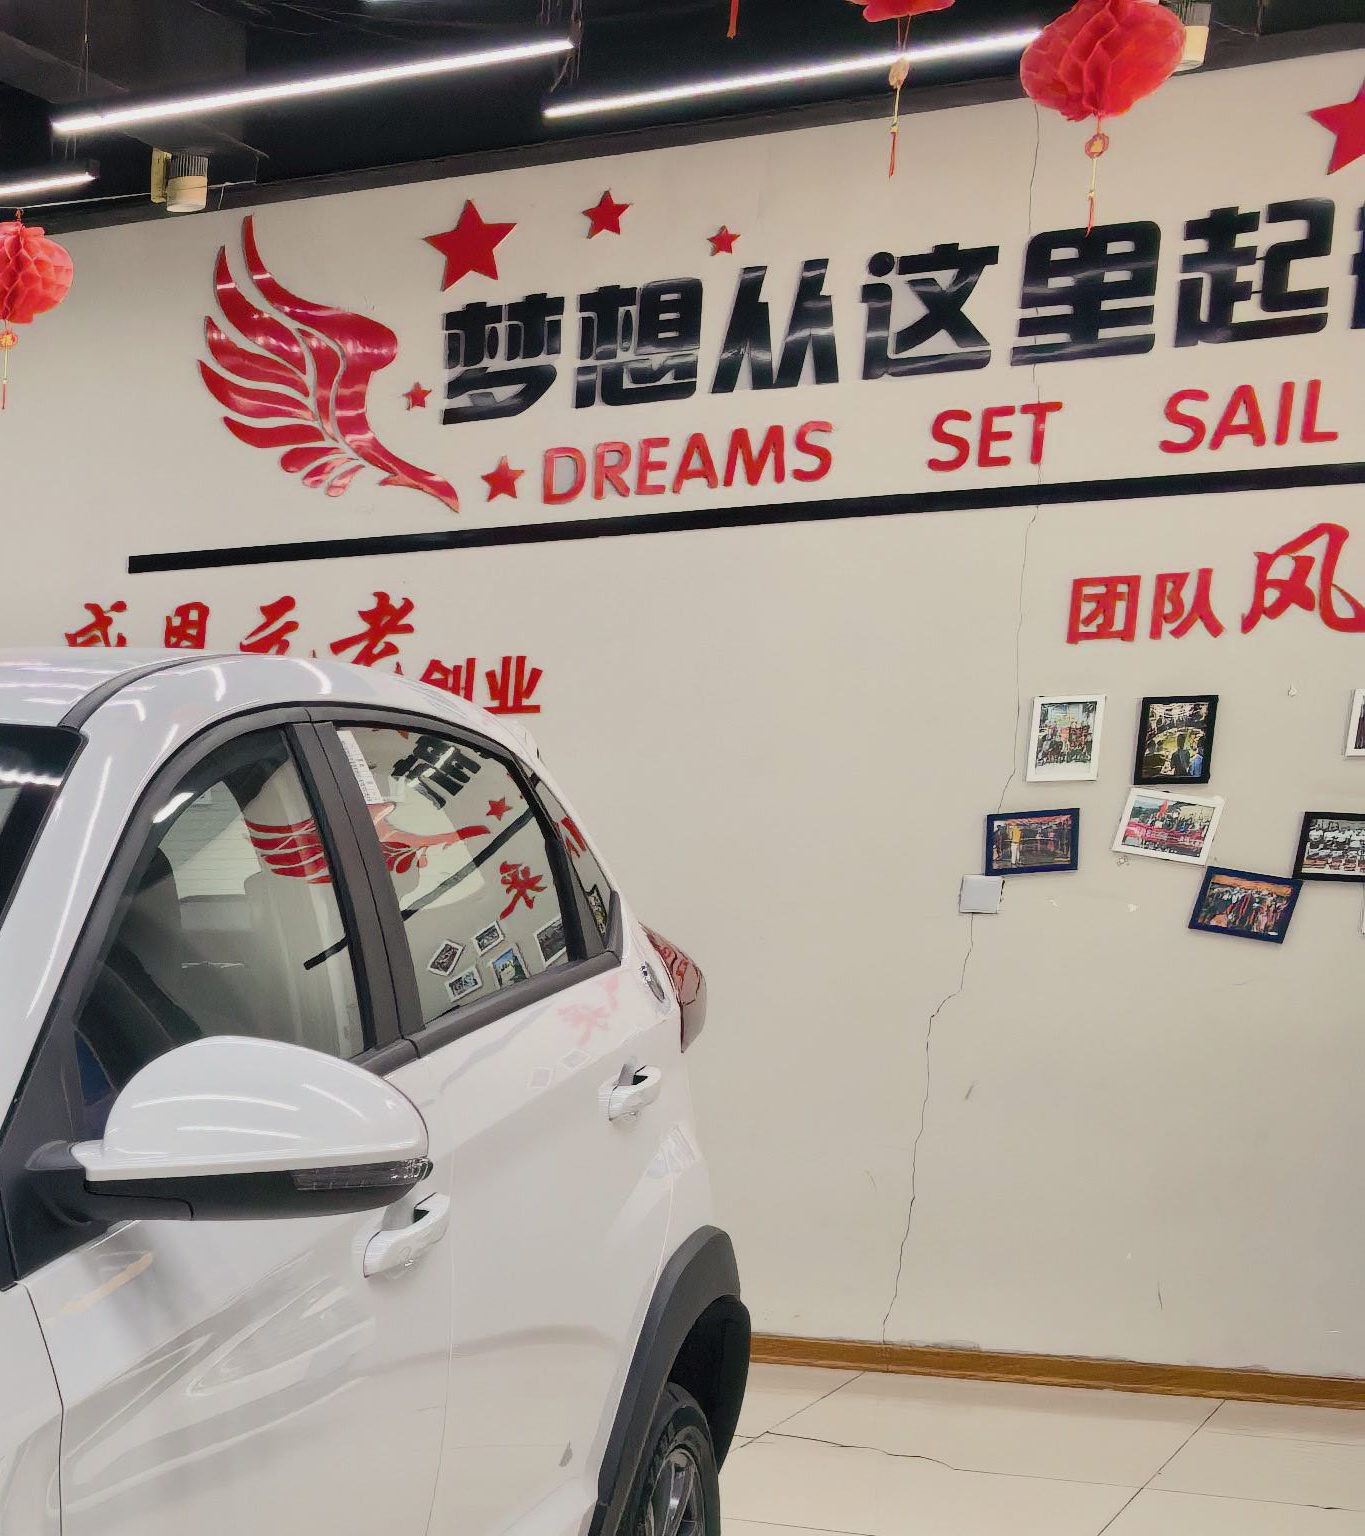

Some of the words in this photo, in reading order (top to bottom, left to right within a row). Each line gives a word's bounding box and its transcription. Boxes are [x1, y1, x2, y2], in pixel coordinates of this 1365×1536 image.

[441, 197, 1365, 426] 梦想从这里起
[541, 420, 833, 506] DREAMS
[927, 401, 1064, 472] SET
[1158, 378, 1339, 454] SAIL
